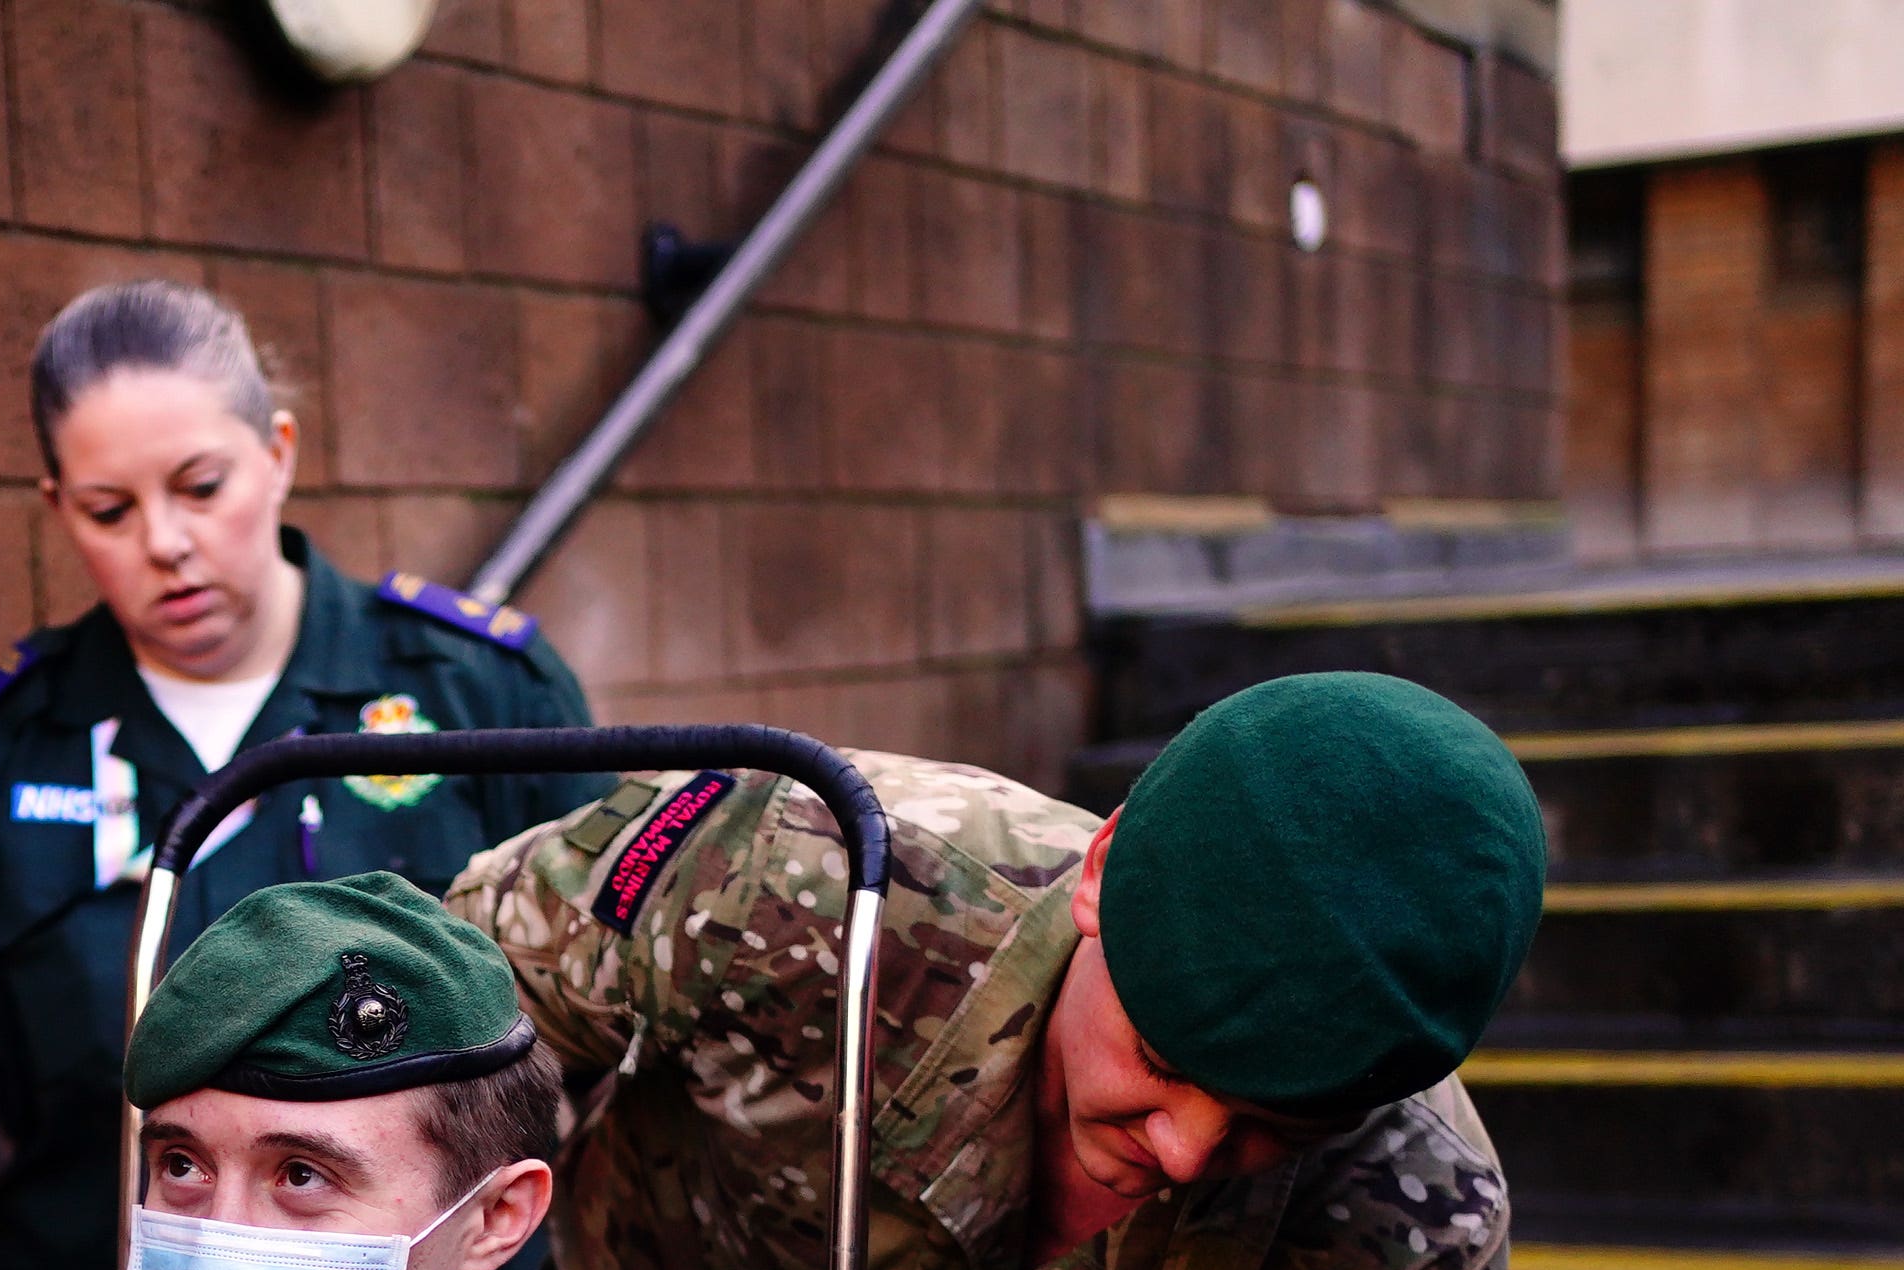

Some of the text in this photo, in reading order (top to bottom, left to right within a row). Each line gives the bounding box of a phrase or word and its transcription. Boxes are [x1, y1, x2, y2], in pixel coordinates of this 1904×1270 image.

[611, 791, 694, 891] COMMANDO
[615, 780, 723, 920] ROYAL MARINES
